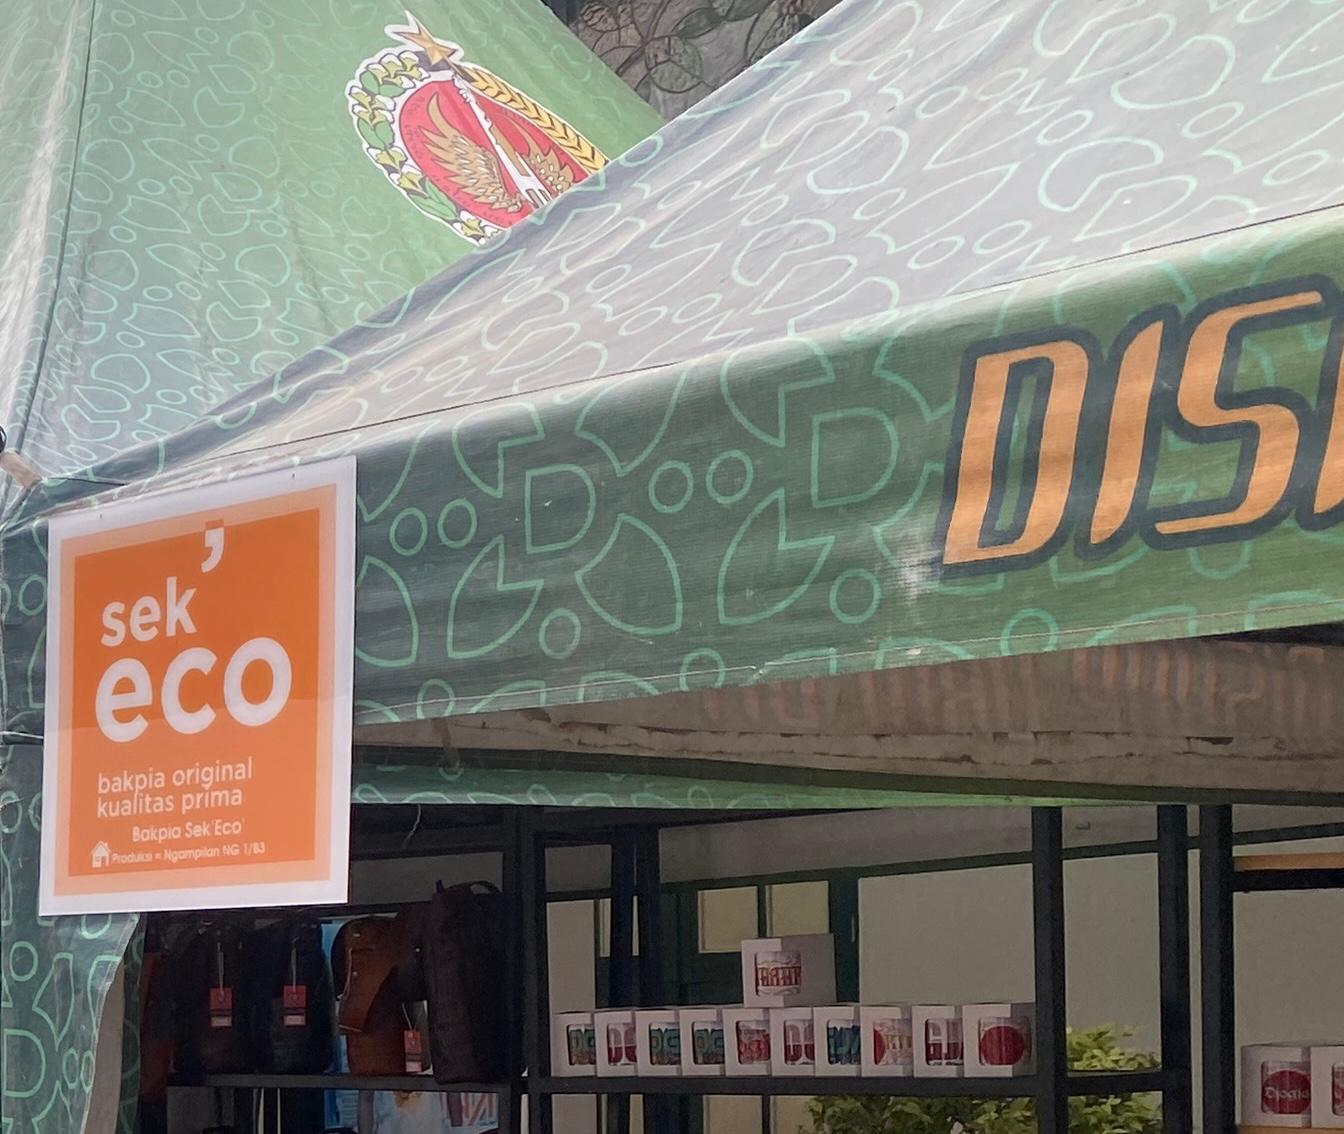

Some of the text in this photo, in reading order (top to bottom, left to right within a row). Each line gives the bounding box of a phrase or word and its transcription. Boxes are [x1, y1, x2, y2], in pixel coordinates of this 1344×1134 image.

[943, 289, 1344, 565] DIS
[95, 637, 293, 743] eco
[98, 757, 253, 797] bakpia original
[97, 784, 243, 819] kualitas prima
[132, 825, 181, 843] Bakpia
[112, 852, 153, 865] Produksi
[164, 846, 220, 863] Ngampilan
